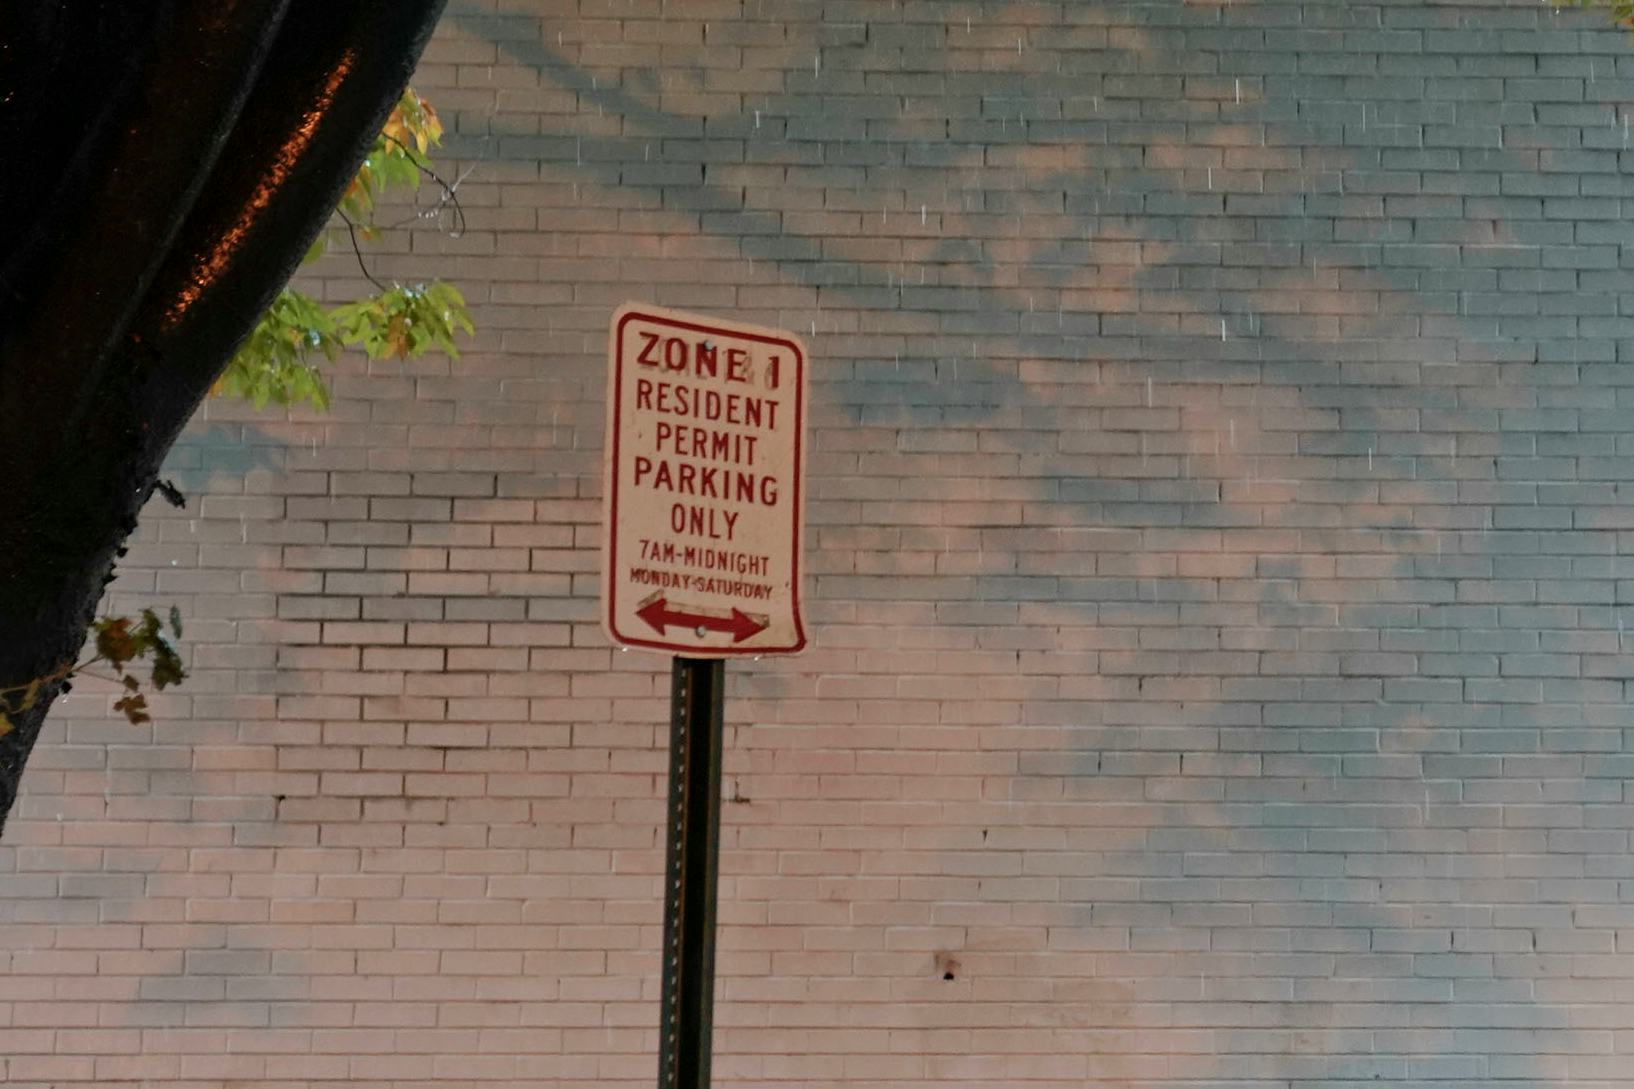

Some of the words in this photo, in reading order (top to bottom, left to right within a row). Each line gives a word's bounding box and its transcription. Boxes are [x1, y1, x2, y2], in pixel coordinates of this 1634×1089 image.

[636, 332, 747, 383] ZONE
[768, 356, 780, 389] 1
[636, 378, 779, 430] RESIDENT
[656, 422, 757, 466] PERMIT
[634, 456, 777, 506] PARKING
[671, 503, 739, 541] ONLY
[639, 539, 770, 577] 7AM-MIDNIGHT
